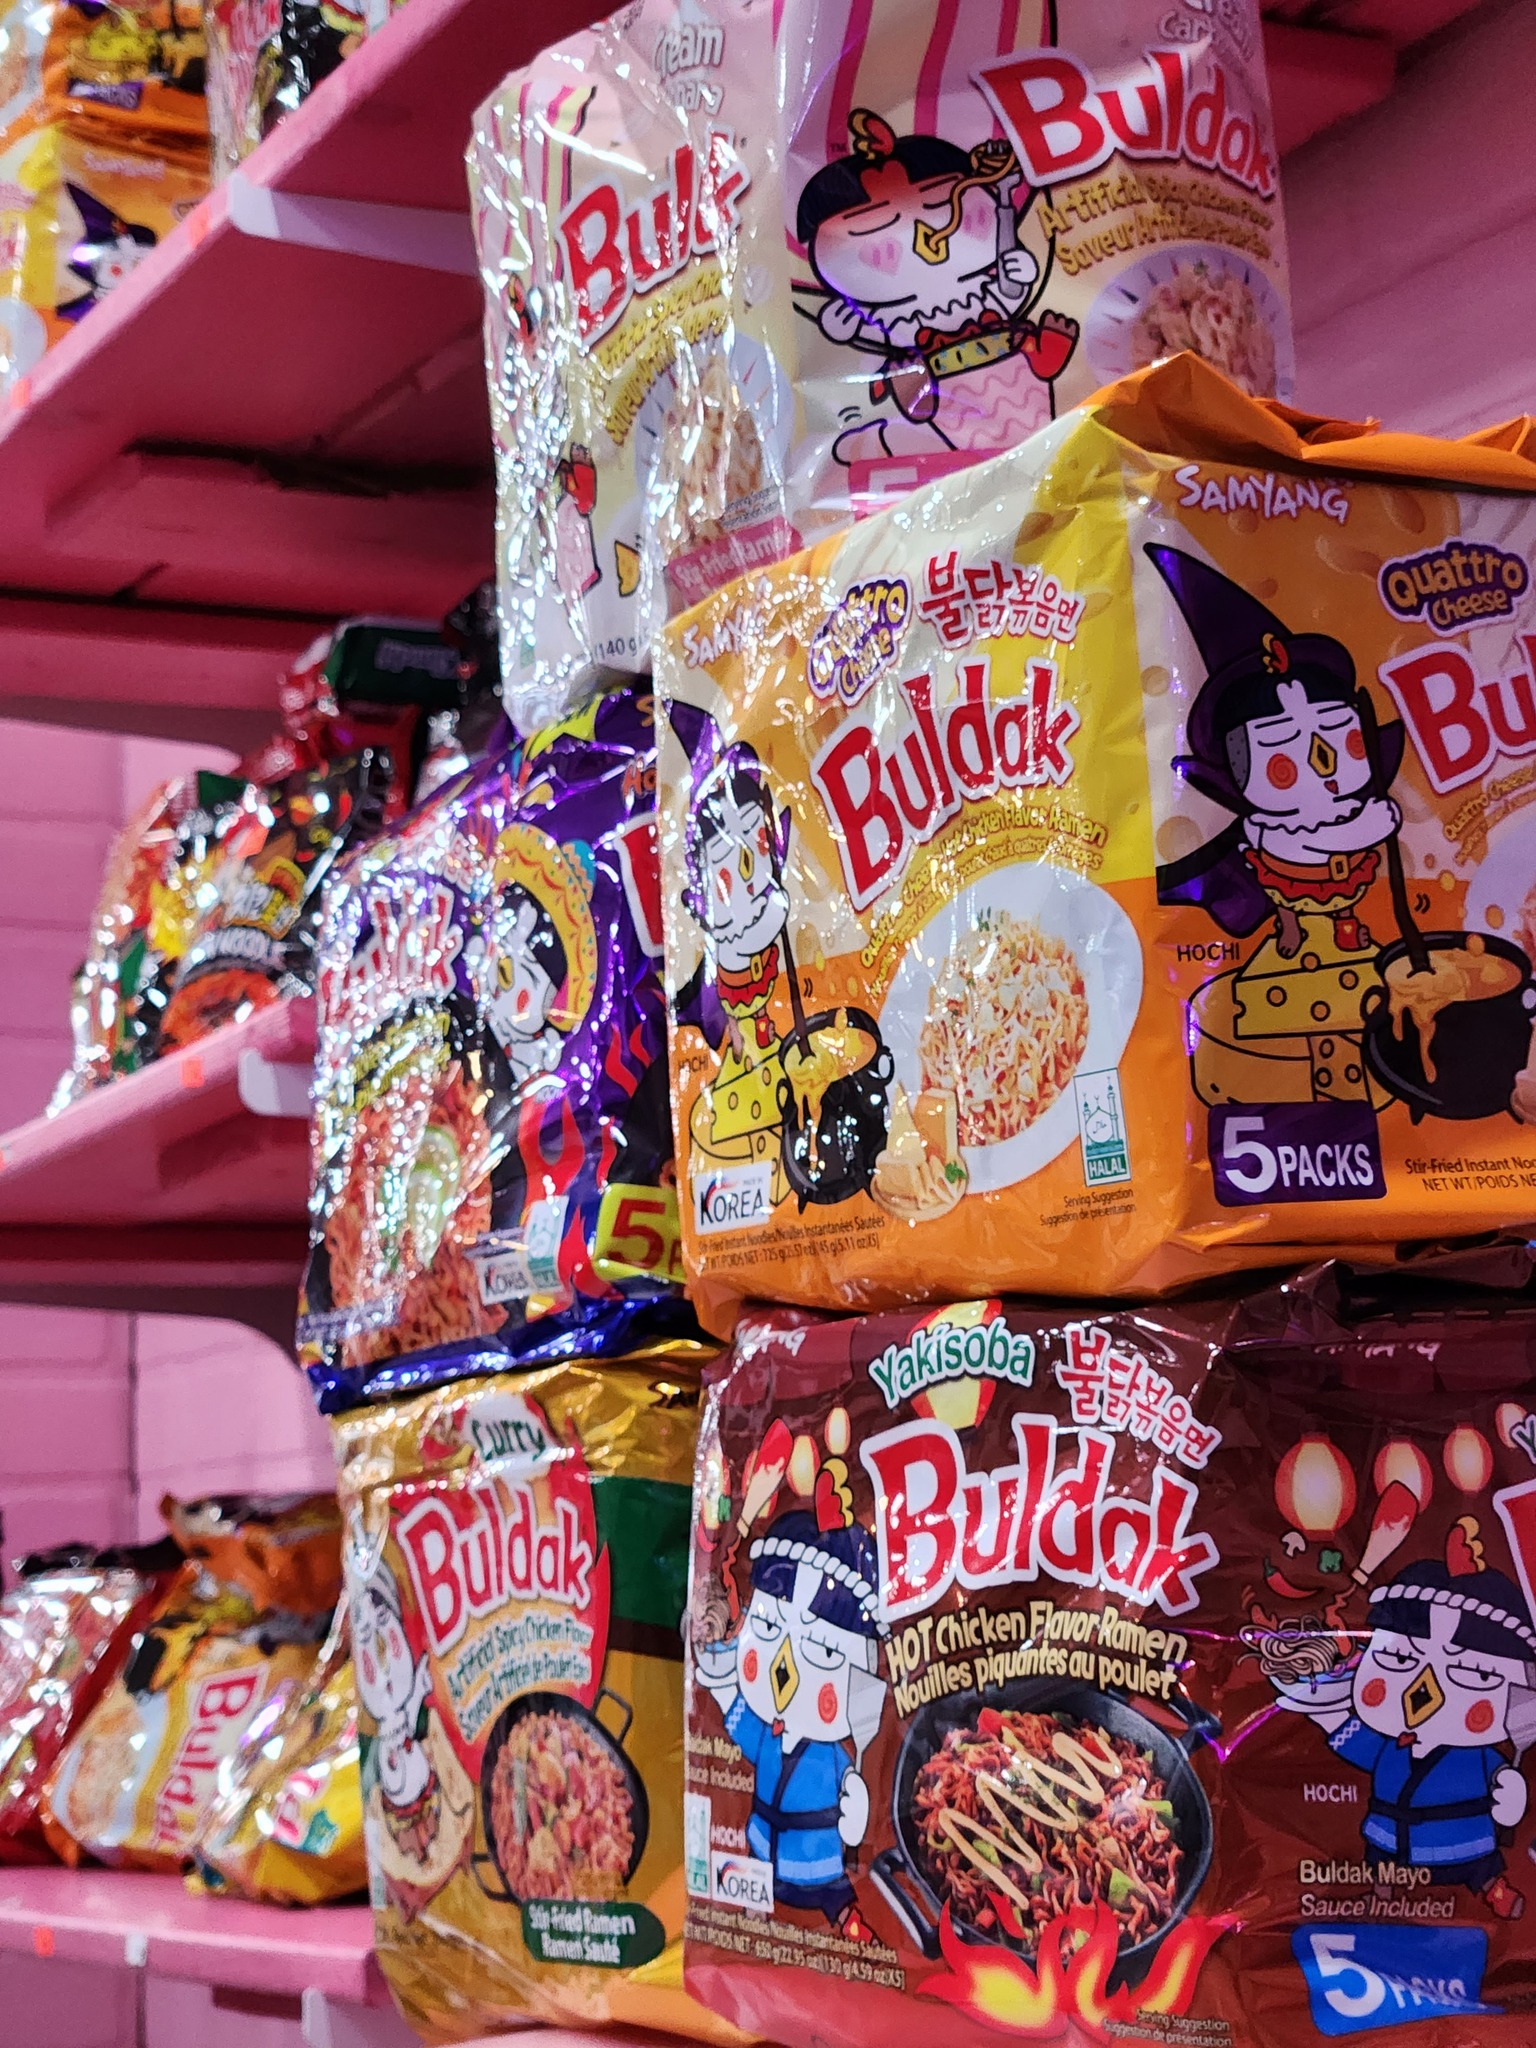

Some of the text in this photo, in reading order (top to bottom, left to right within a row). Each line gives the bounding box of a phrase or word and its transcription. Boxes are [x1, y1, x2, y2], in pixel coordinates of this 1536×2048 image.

[972, 48, 1274, 196] Buldak
[1174, 465, 1350, 524] SAMYANG
[1387, 550, 1524, 607] Quattro
[1433, 588, 1508, 627] Cheese
[816, 660, 1076, 905] Buldak
[1177, 943, 1240, 963] HOCHI
[1088, 1156, 1126, 1179] HALAL
[1223, 1115, 1375, 1194] 5 PACKS
[1404, 1157, 1463, 1175] Stir-Fried
[1464, 1157, 1511, 1172] Instant
[1064, 1187, 1134, 1209] Serving Suggestion
[1422, 1177, 1449, 1191] NET
[700, 1187, 766, 1226] KOREA
[610, 1197, 667, 1269] 5
[872, 1320, 1034, 1403] Yakisoba
[471, 1416, 546, 1461] Curry
[870, 1418, 1216, 1612] Buldak
[398, 1485, 594, 1650] Buldak
[886, 1600, 1188, 1684] HOT Chicken Flavor Ramen
[892, 1639, 1179, 1719] Nouilles piquantes au poulet
[713, 1735, 743, 1766] Mayo
[1303, 1783, 1358, 1803] HOCHI
[716, 1866, 770, 1906] KOREA
[1299, 1859, 1432, 1891] Buldak Mayo
[583, 1905, 637, 1936] Ramen
[1300, 1893, 1456, 1919] Sauce Included
[541, 1931, 584, 1960] Ramen
[1309, 1932, 1386, 2018] 5
[1136, 2007, 1230, 2033] Serving Suggestion
